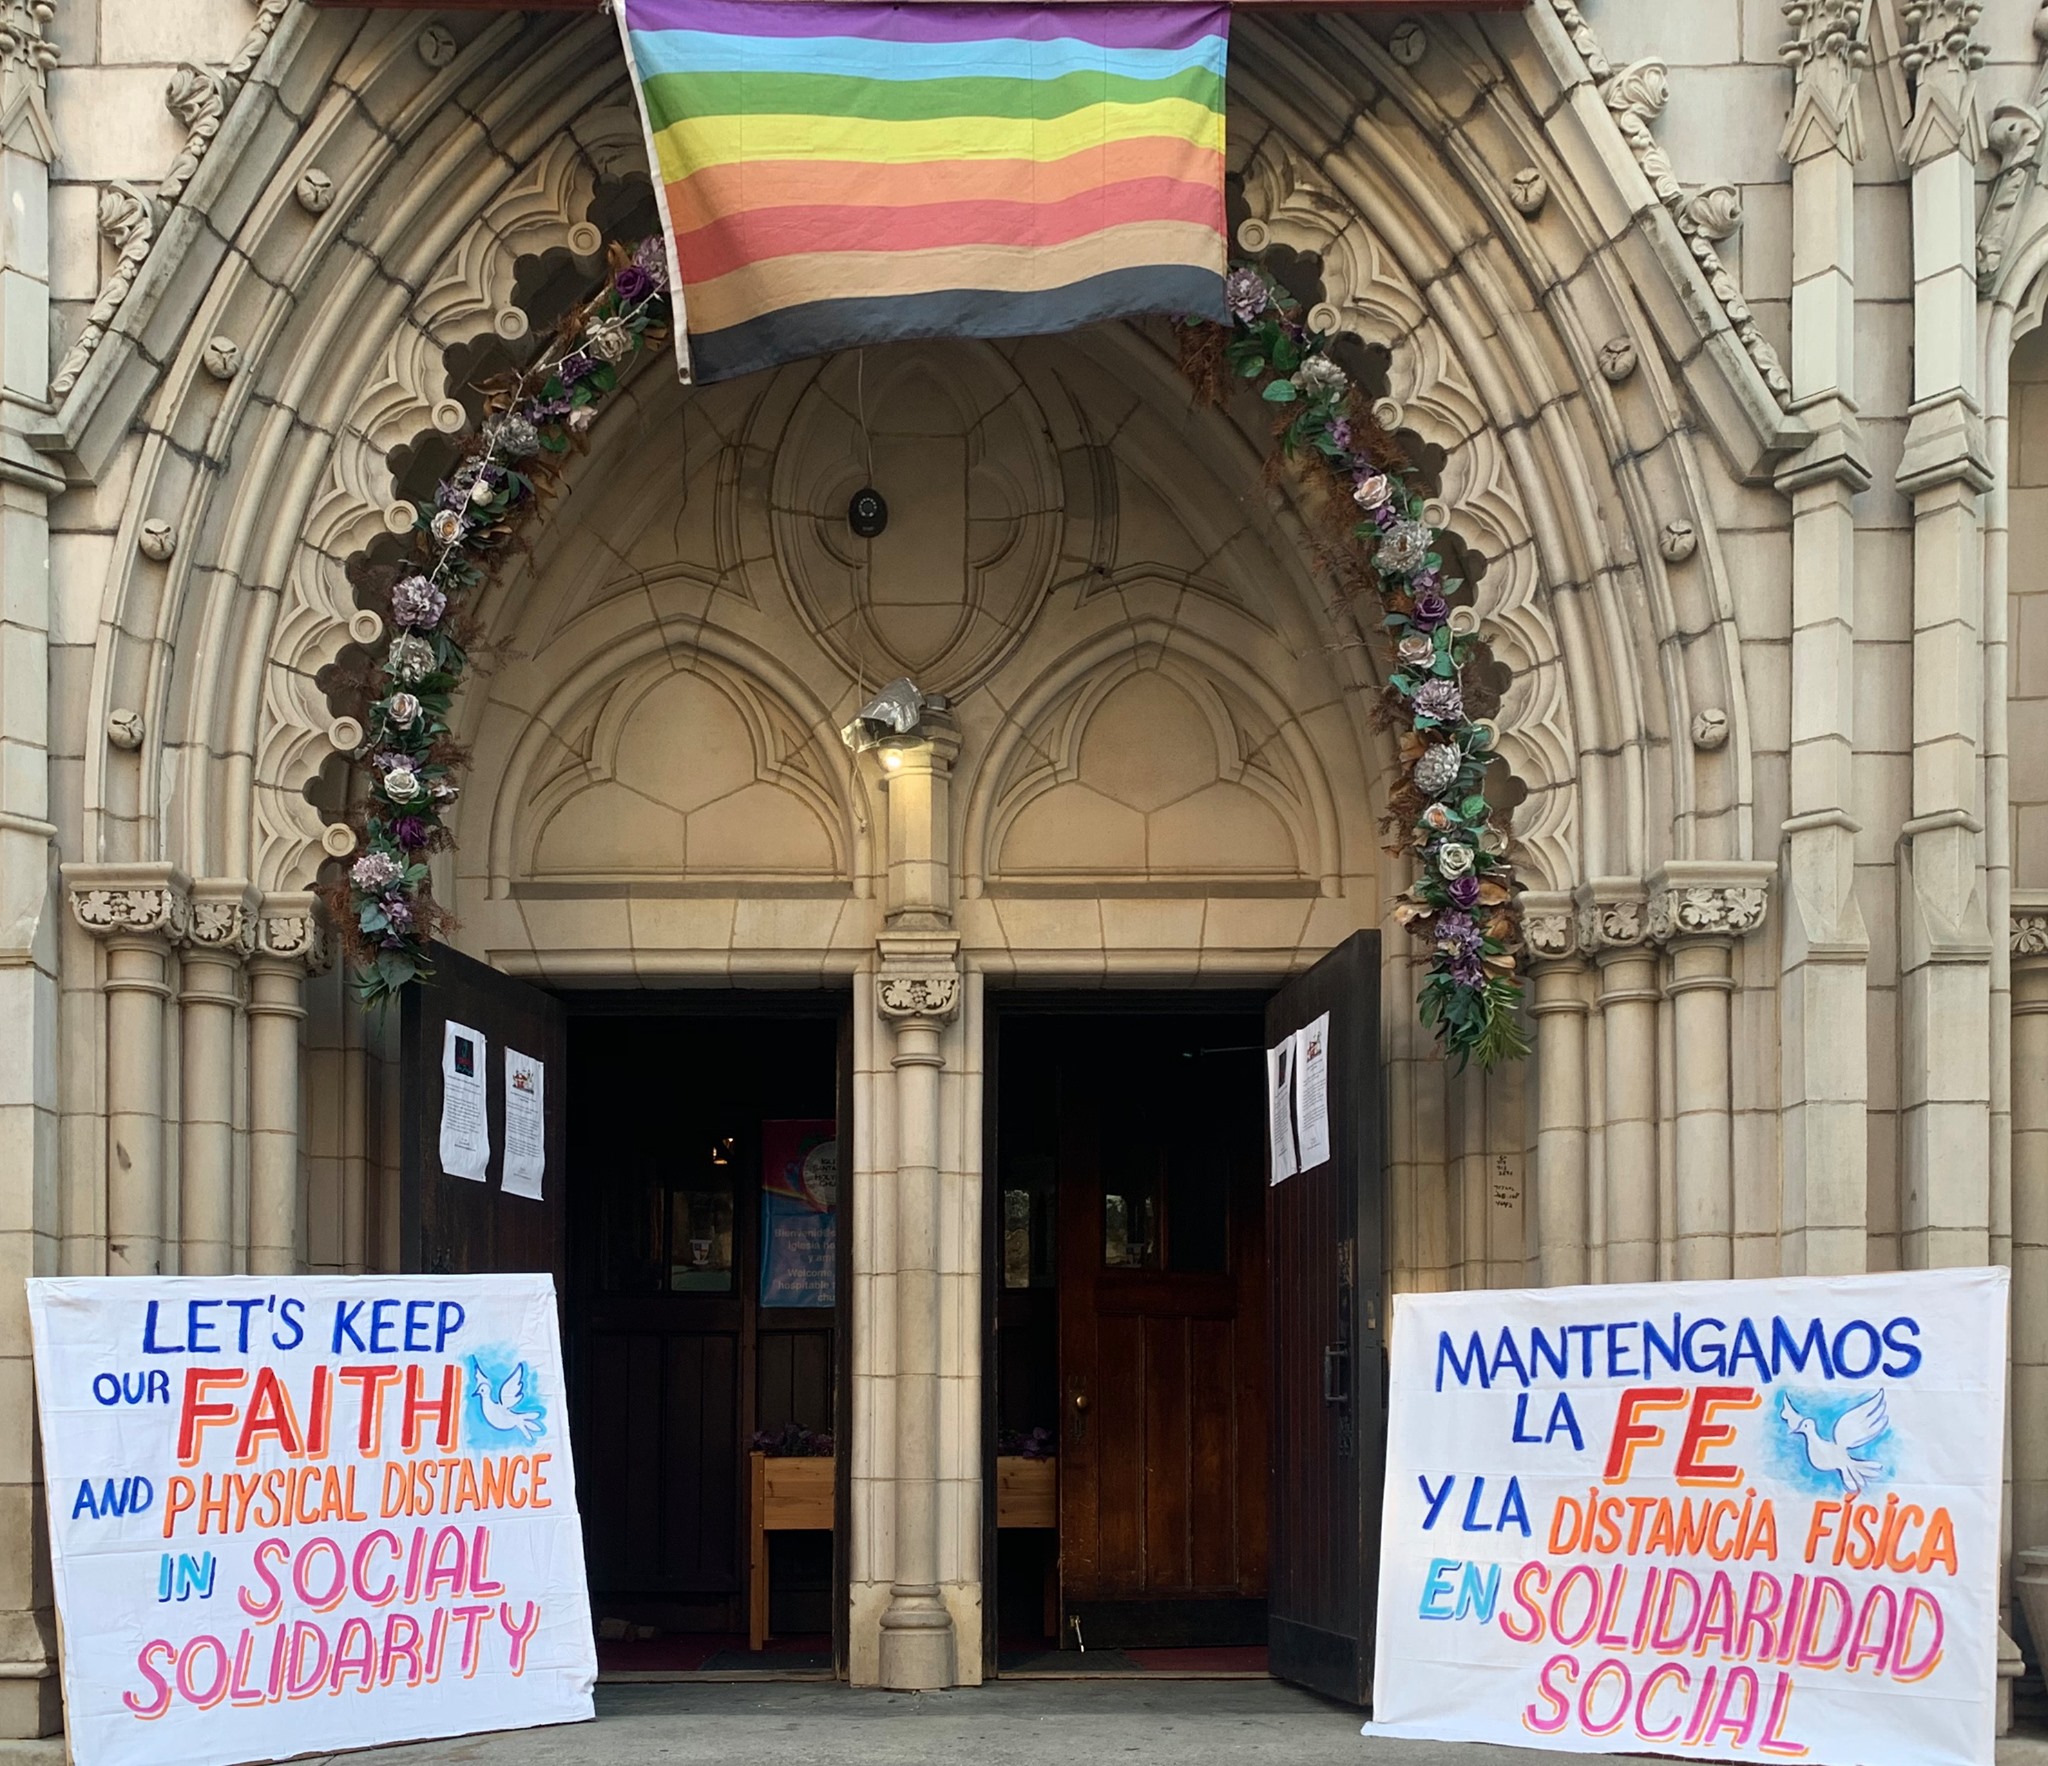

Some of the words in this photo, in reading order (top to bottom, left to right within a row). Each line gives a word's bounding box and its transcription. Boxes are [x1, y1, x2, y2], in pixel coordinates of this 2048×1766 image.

[777, 1280, 829, 1290] hospitable
[788, 1241, 821, 1251] Iglesia
[142, 1295, 304, 1354] LET'S
[332, 1300, 465, 1354] KEEP
[1436, 1312, 1922, 1392] MANTENGAMOS
[93, 1370, 170, 1406] OUR
[177, 1365, 460, 1466] FAITH
[1512, 1392, 1584, 1450] LA
[1602, 1387, 1762, 1487] FE
[72, 1476, 153, 1520] AND
[162, 1467, 367, 1538] PHYSICAL
[380, 1453, 551, 1518] DISTANCE
[1418, 1475, 1454, 1531] Y
[1462, 1476, 1530, 1537] LA
[158, 1550, 215, 1602] IN
[238, 1526, 504, 1625] SOCIAL
[1418, 1557, 1500, 1624] EN
[1499, 1560, 1944, 1682] SOLIDARIDAD
[122, 1600, 540, 1720] SOLIDARITY
[1522, 1654, 1810, 1758] SOCIAL
